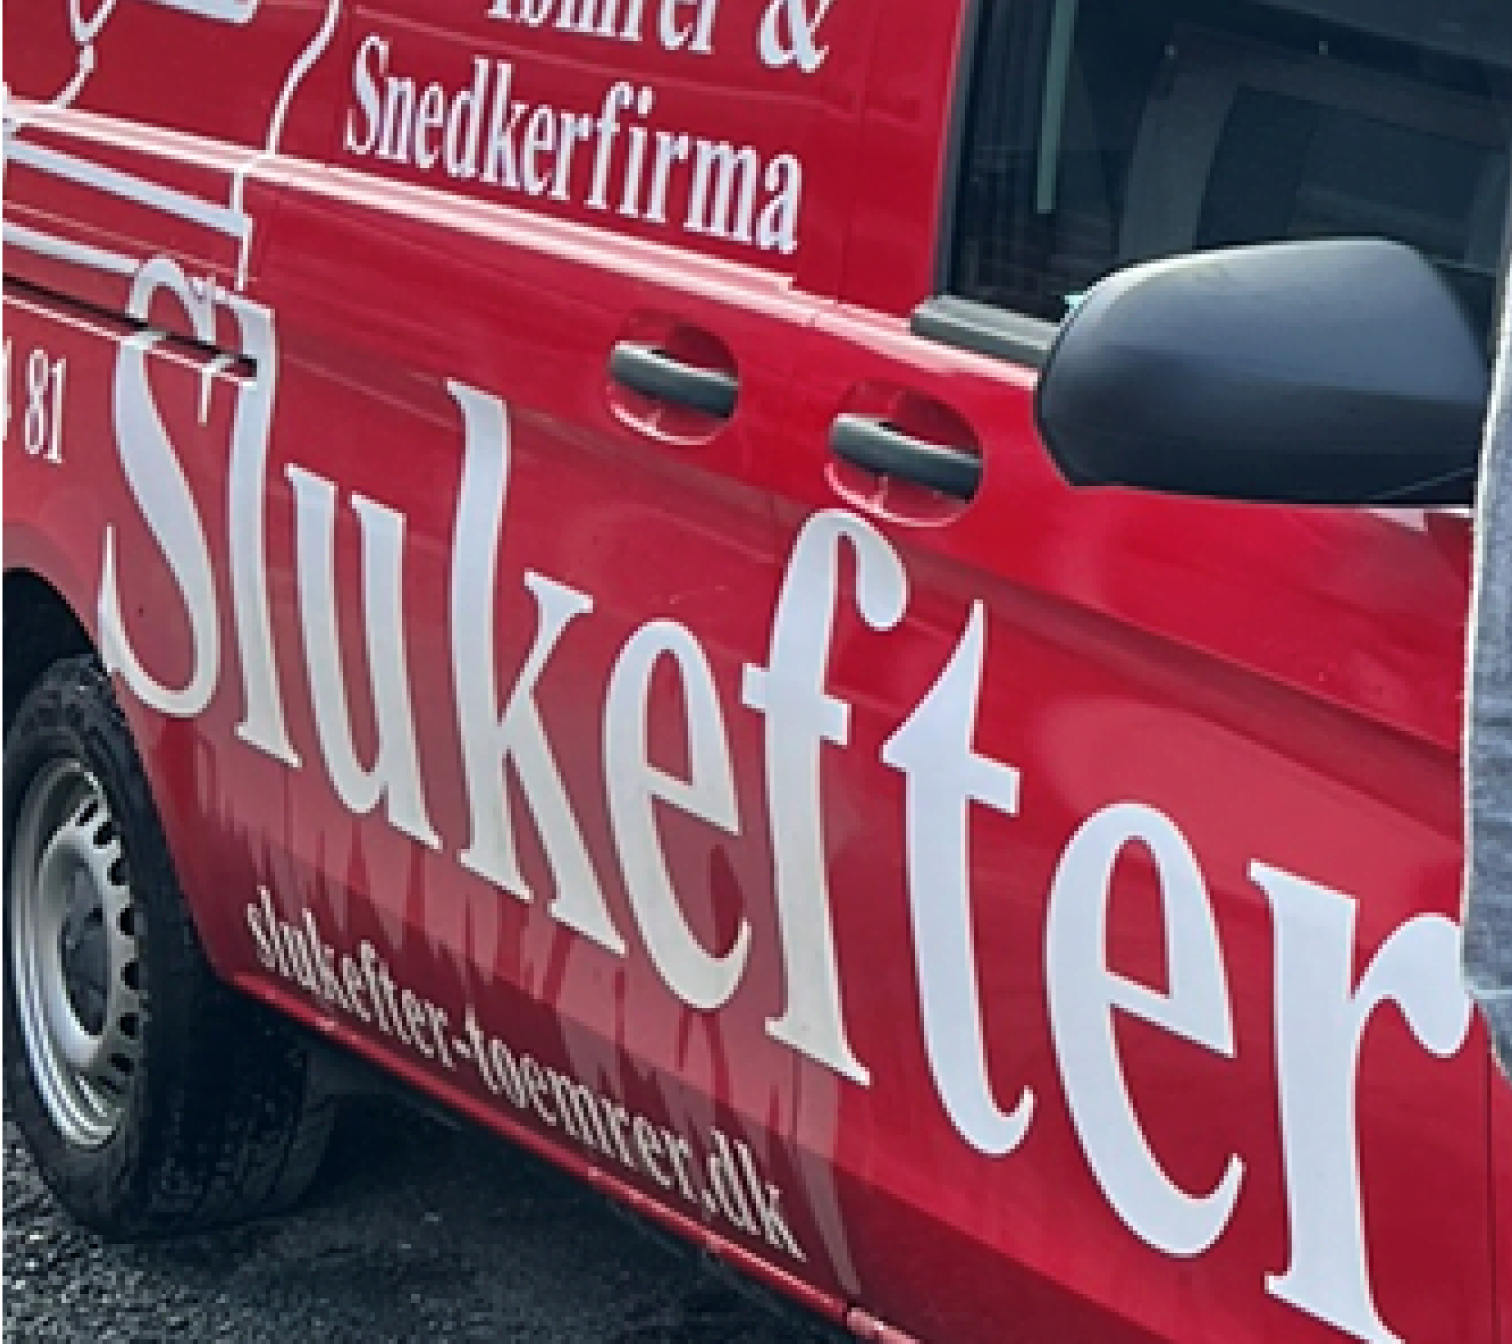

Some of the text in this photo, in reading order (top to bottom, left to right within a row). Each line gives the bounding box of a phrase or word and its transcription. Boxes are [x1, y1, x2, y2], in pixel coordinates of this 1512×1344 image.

[342, 33, 804, 256] Snedkerfirma
[24, 348, 67, 465] 81
[246, 884, 806, 1264] slukefter-toemrer.dk
